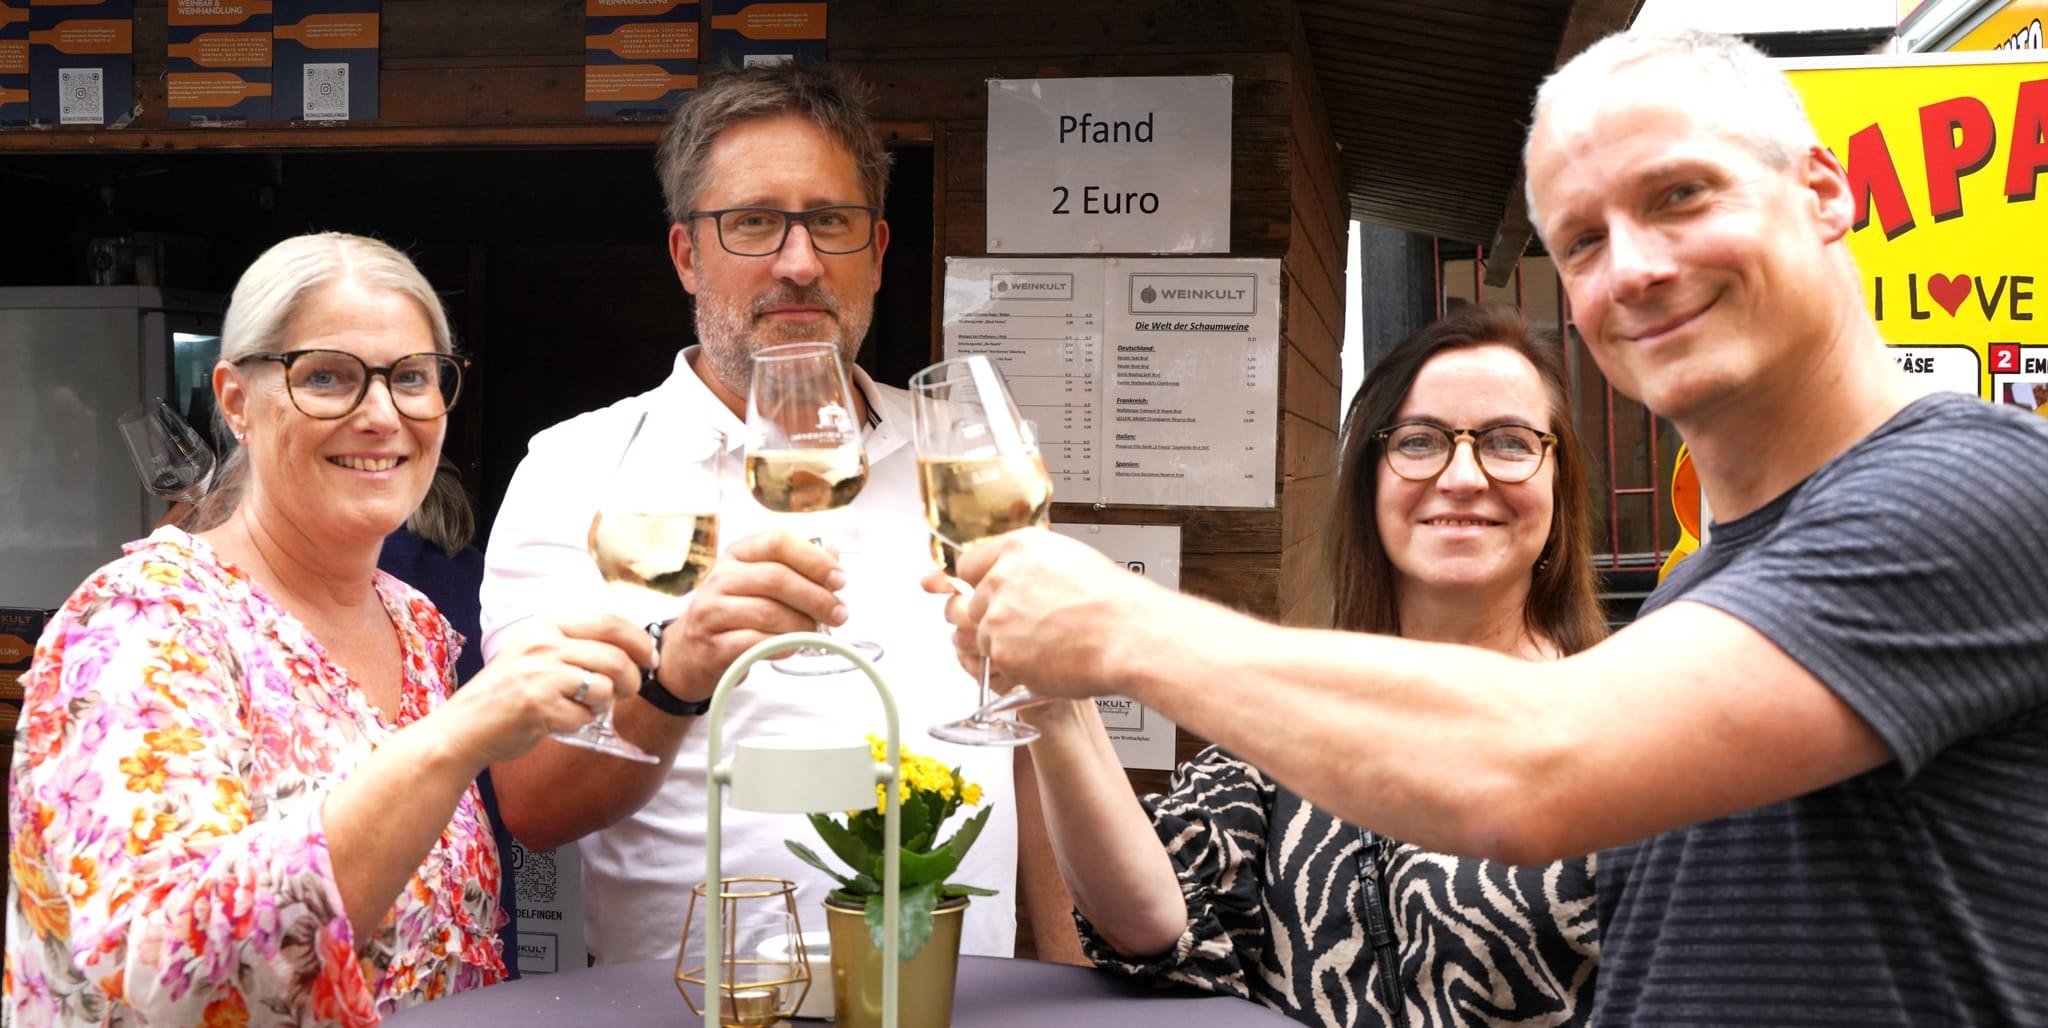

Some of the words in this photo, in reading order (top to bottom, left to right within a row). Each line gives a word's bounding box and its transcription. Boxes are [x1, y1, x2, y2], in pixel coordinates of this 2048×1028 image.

[178, 7, 243, 15] WEINHANDLUNG
[1060, 112, 1154, 144] Pfand
[1052, 186, 1070, 214] 2
[1083, 186, 1159, 214] Euro
[1011, 282, 1067, 291] WEINKULT
[1161, 289, 1246, 300] WEINKULT
[1874, 276, 1883, 321] I
[1135, 321, 1150, 332] Die
[1152, 321, 1172, 332] Welt
[1174, 321, 1188, 332] der
[1190, 321, 1250, 333] Schaumweine
[1117, 345, 1156, 353] Deutschland:
[1897, 352, 1934, 374] ÄSE
[1997, 350, 2012, 368] 2
[2025, 357, 2048, 374] EM
[1116, 397, 1149, 405] Frankreich:
